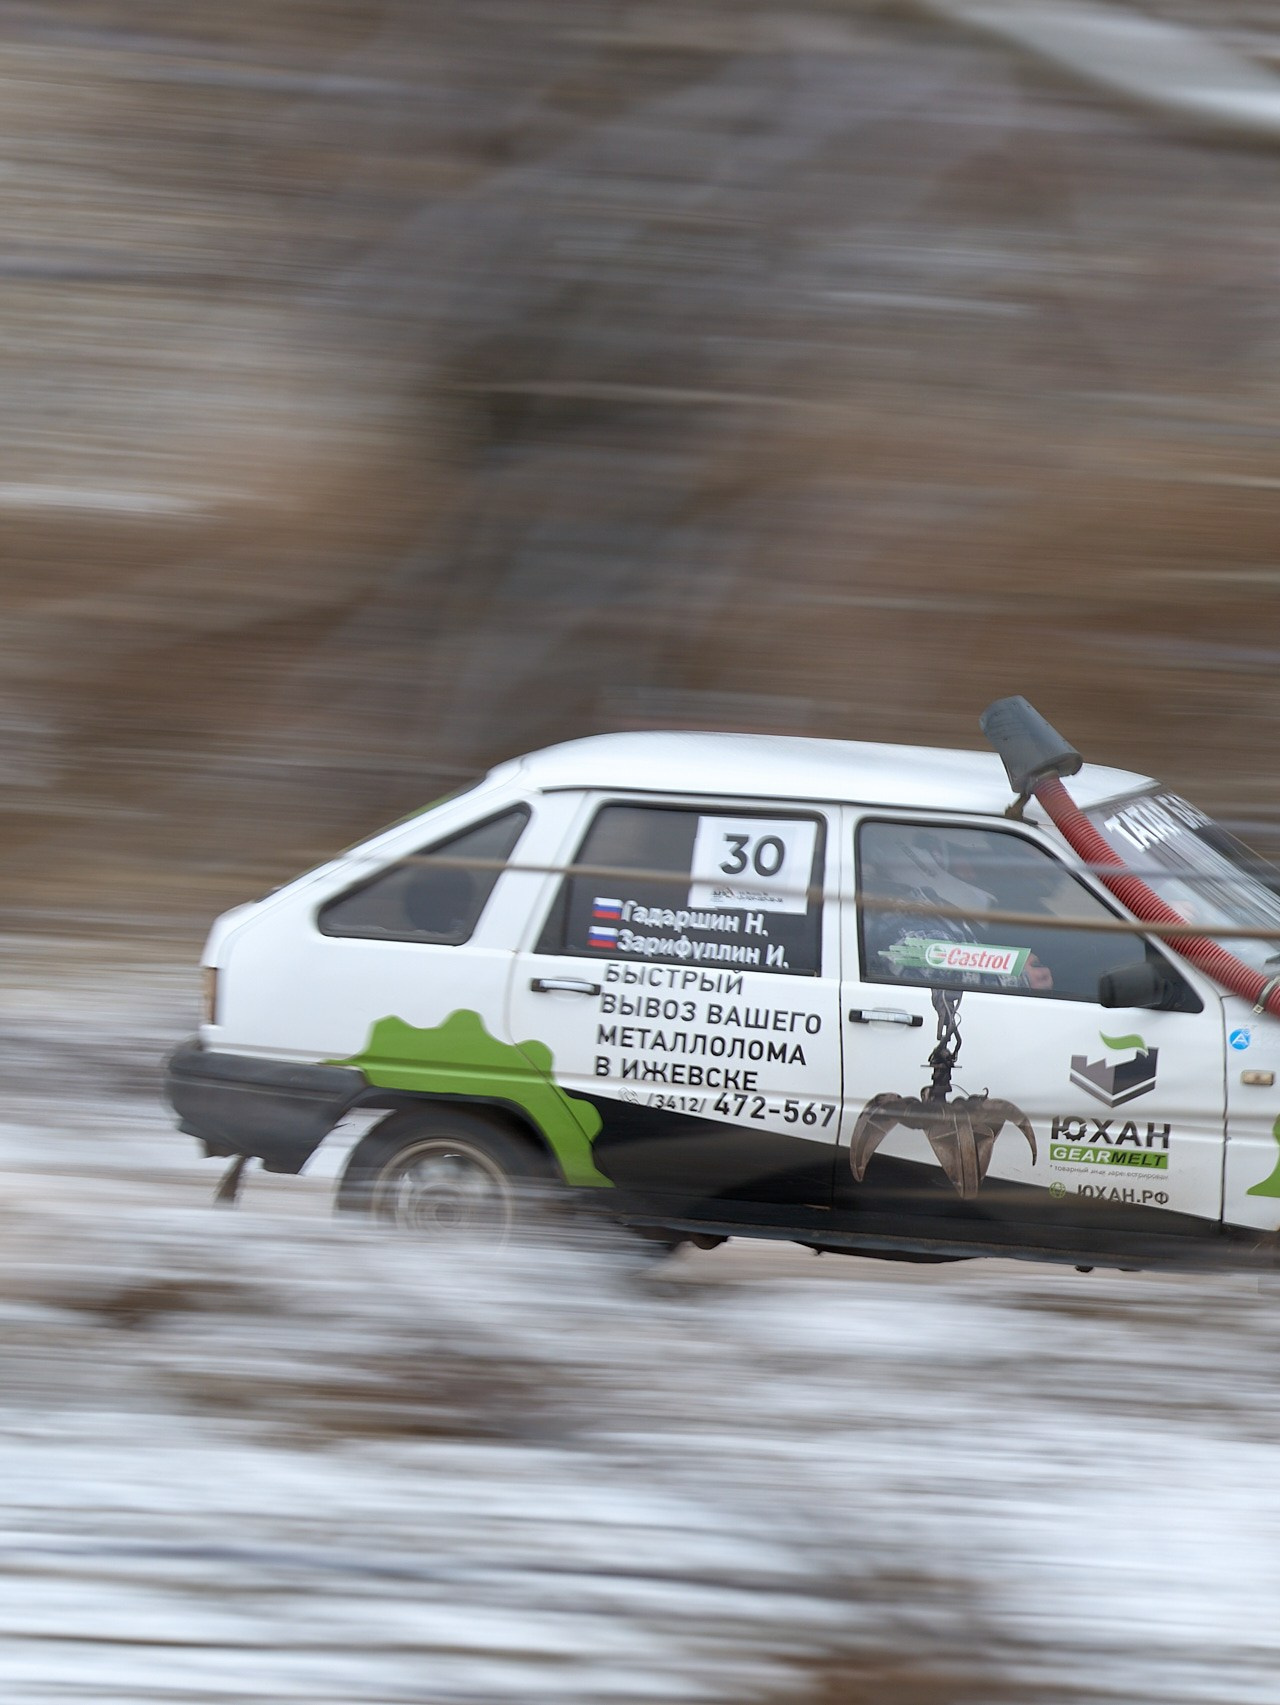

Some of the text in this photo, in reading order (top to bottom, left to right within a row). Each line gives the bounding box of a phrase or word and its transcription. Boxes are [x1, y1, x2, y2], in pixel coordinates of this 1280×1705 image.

[718, 832, 786, 877] 30
[620, 900, 769, 937] Гадаршин Н.
[616, 928, 790, 969] Зарифуллин И.
[947, 947, 1012, 970] Castrol
[604, 961, 745, 996] БЫСТРЫЙ
[599, 992, 823, 1035] ВЫВОЗ ВАШЕГО
[596, 1023, 807, 1066] МЕТАЛЛОЛОМА
[593, 1054, 759, 1092] В ИЖЕВСКЕ
[712, 1091, 837, 1128] 472-567
[1051, 1115, 1171, 1149] ЮХАН
[1052, 1146, 1166, 1167] GEARMELT
[1077, 1183, 1170, 1205] ЮХАН.РФ
